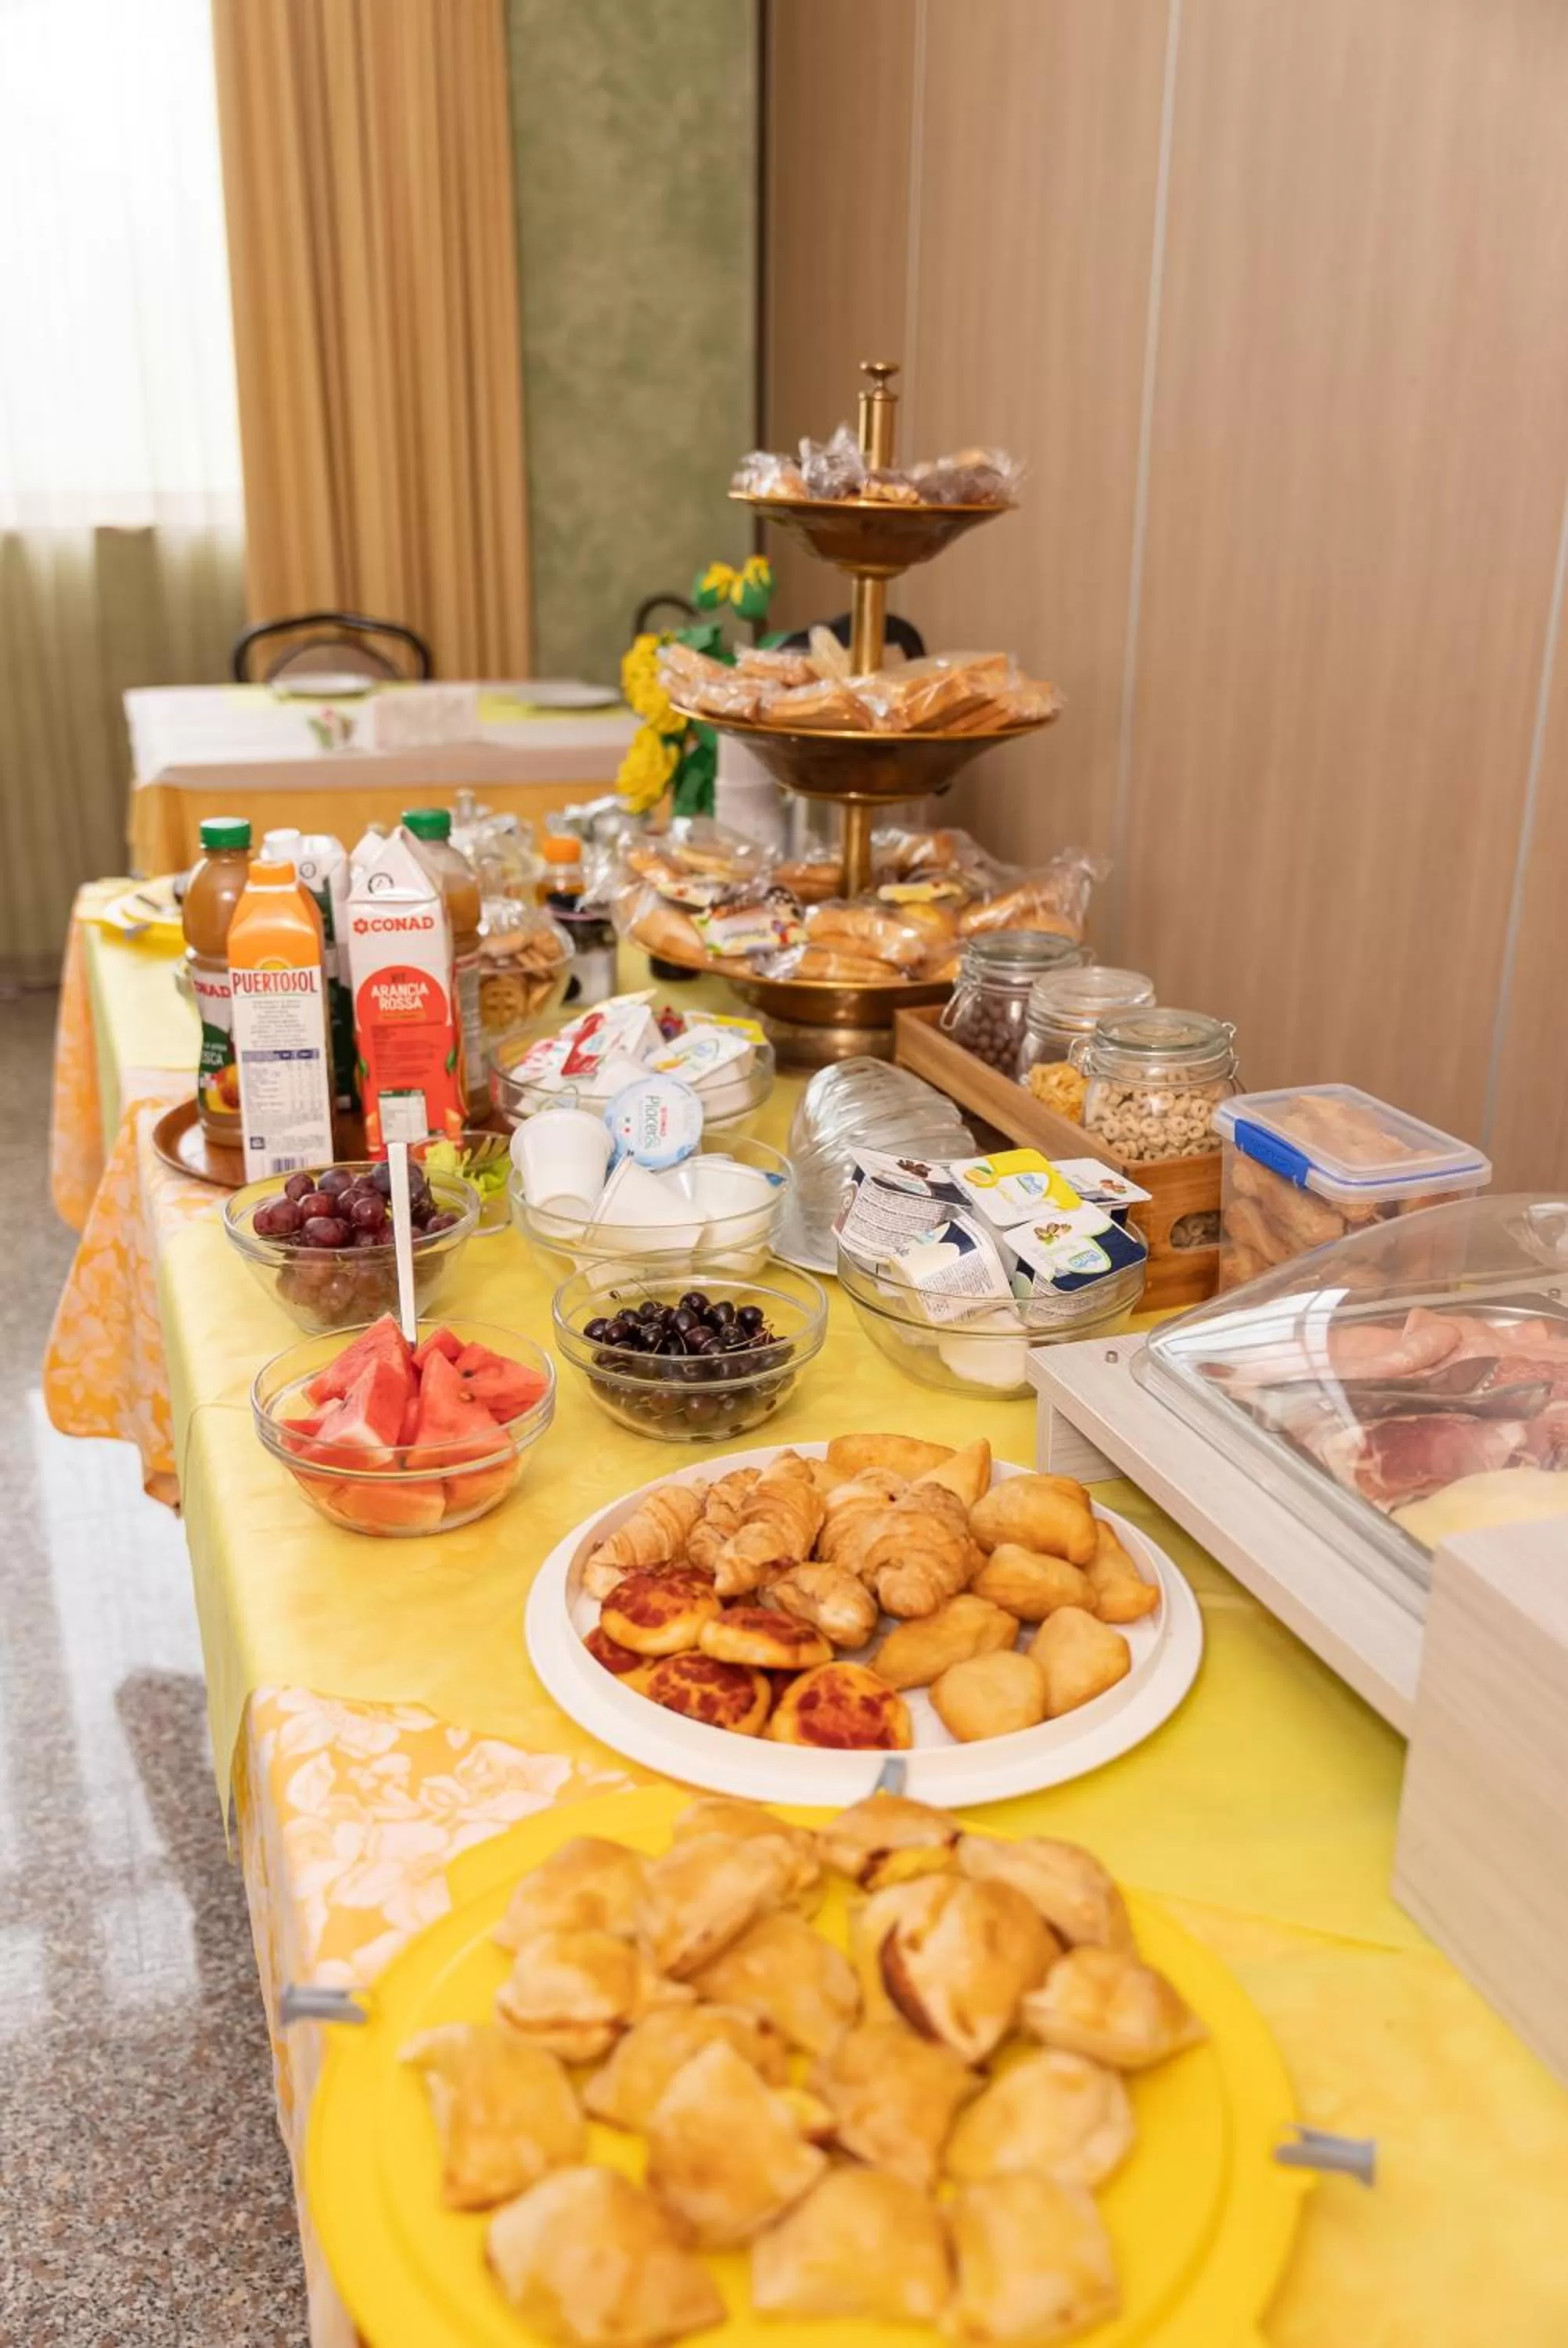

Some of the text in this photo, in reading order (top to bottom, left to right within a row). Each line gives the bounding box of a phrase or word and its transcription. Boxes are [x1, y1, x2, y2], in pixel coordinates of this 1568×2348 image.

[371, 917, 434, 932] CONAD
[232, 971, 318, 994] PUERTOSOL
[371, 982, 429, 998] ARANCIA
[379, 996, 423, 1010] ROSSA
